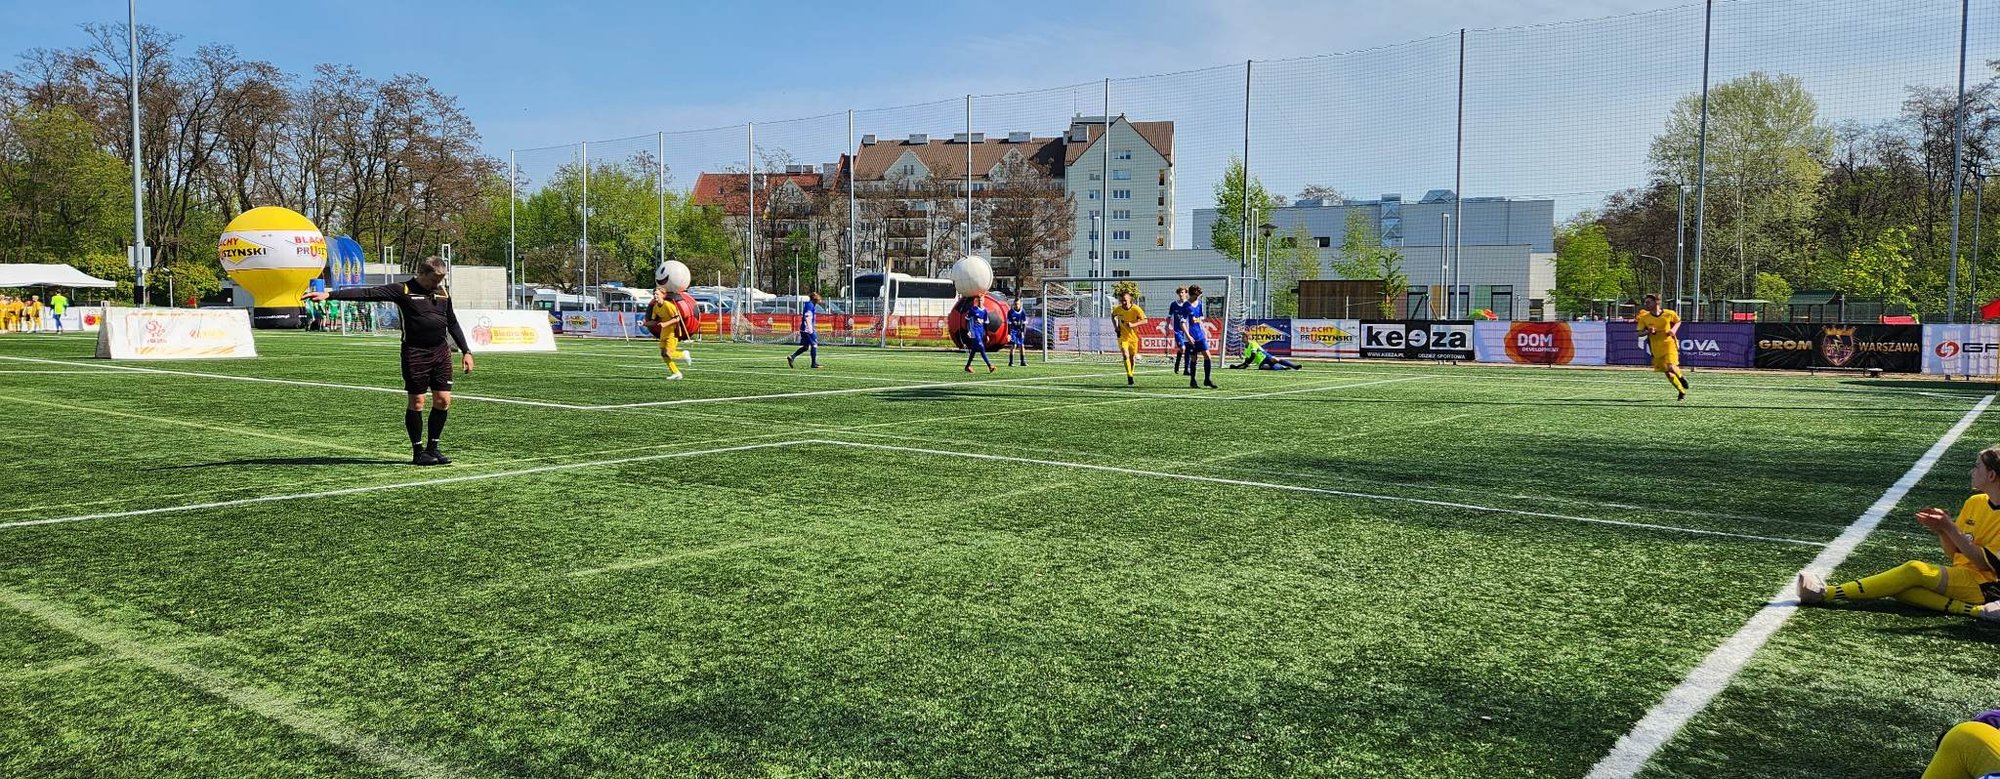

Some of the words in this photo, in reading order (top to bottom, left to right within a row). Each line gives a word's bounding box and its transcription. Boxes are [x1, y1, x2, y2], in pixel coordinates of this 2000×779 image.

[222, 247, 266, 258] SZYNSKI
[1517, 333, 1553, 346] DOM
[1681, 340, 1720, 350] OVA
[1758, 339, 1813, 350] GROM
[1858, 342, 1919, 352] WARSZAWA
